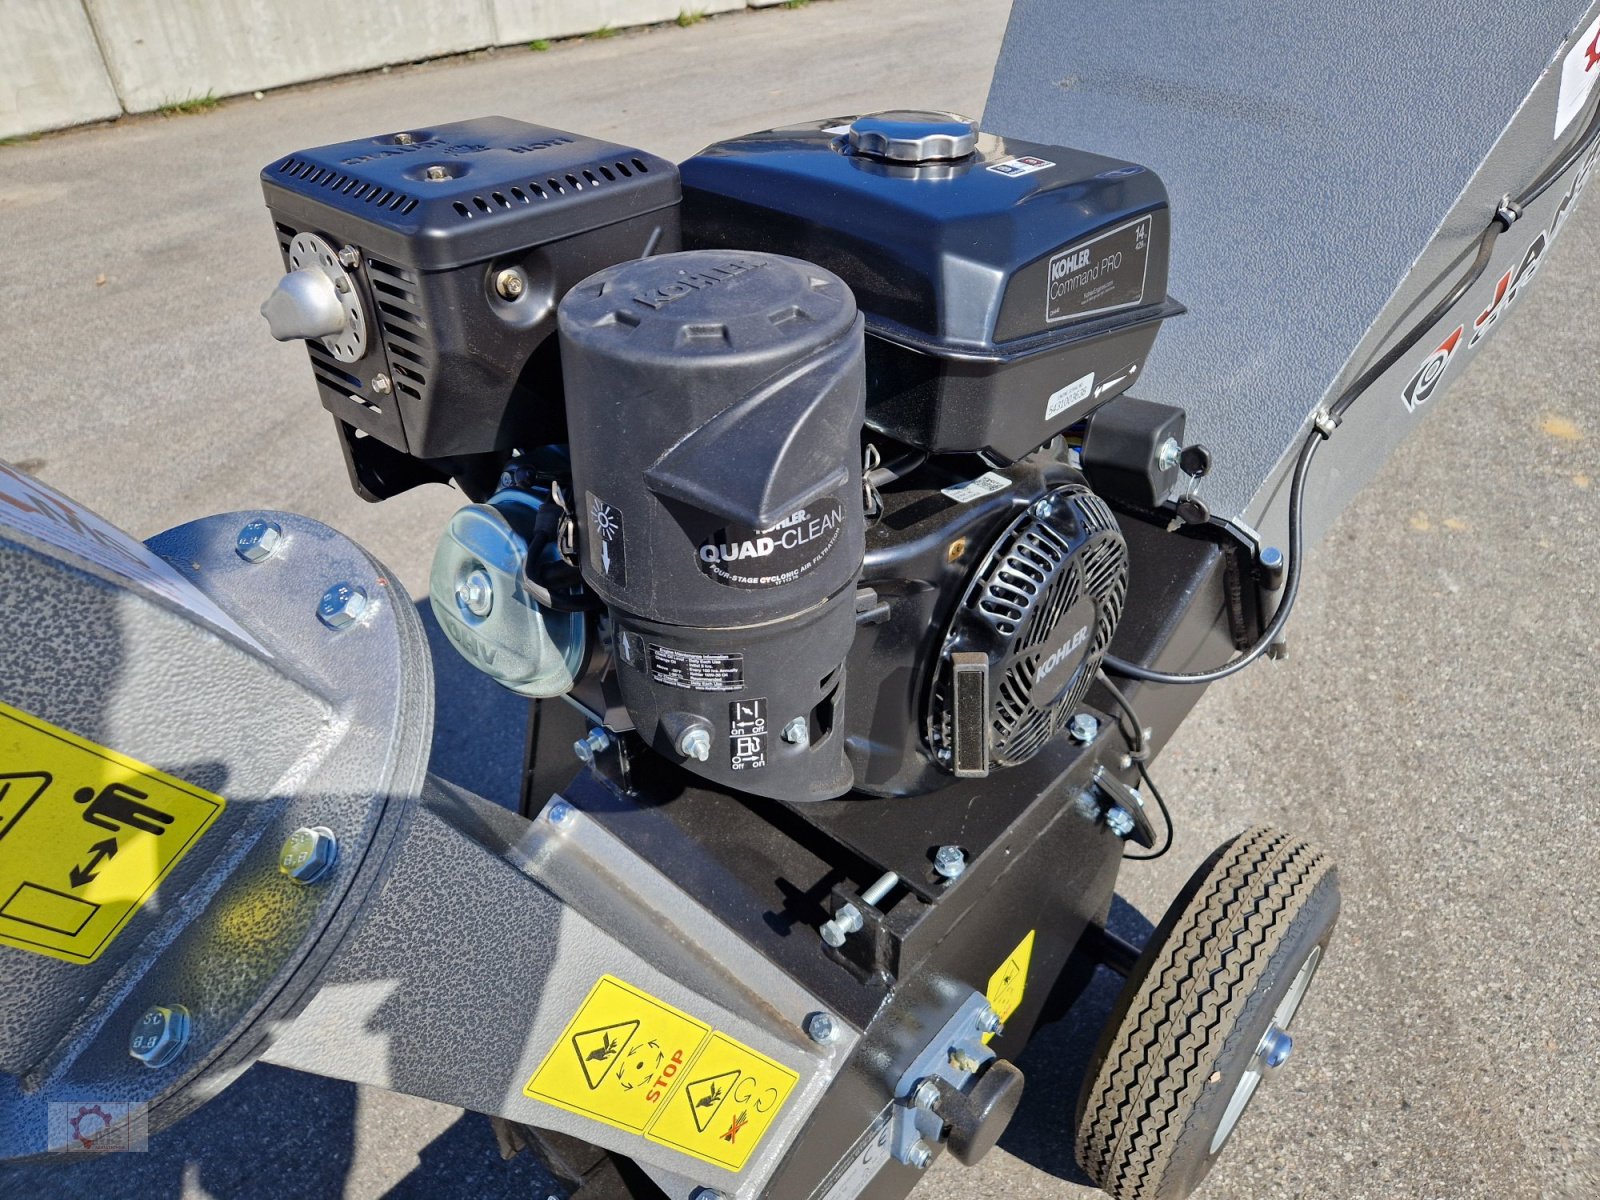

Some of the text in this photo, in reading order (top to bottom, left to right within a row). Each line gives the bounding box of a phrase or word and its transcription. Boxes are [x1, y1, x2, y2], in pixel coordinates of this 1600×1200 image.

[1050, 262, 1100, 300] Command
[1100, 252, 1122, 277] PRO
[1052, 248, 1090, 281] KOHLER
[700, 505, 842, 563] QUAD-CLEAN
[709, 527, 841, 584] FOUR-STAGE CYCLONIC AIR FILTRATION
[1035, 625, 1088, 685] KOHLER
[645, 1048, 684, 1105] STOP
